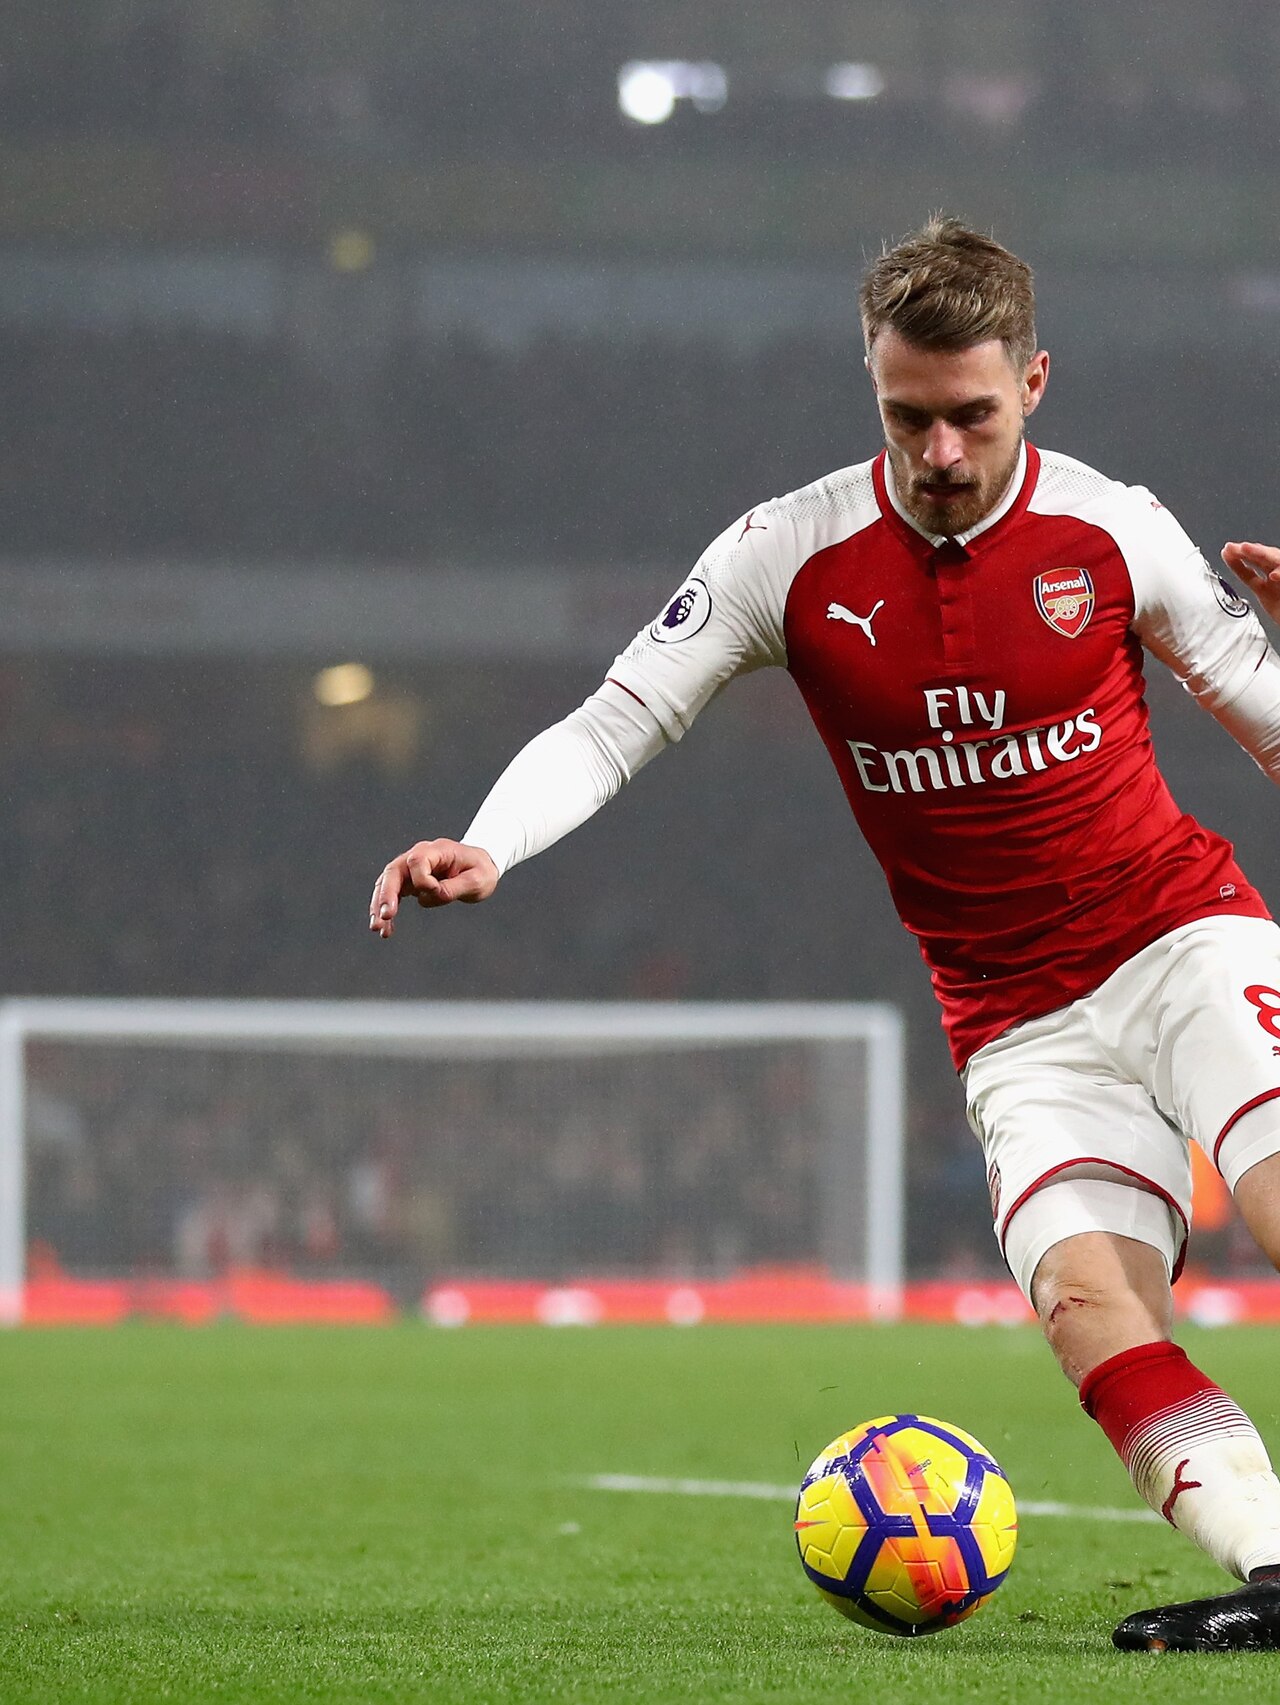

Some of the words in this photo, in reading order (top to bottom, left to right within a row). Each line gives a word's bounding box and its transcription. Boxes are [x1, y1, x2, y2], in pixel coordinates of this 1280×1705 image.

[1041, 576, 1085, 594] Arsenal
[923, 685, 1007, 730] Fly
[847, 708, 1103, 794] Emirates
